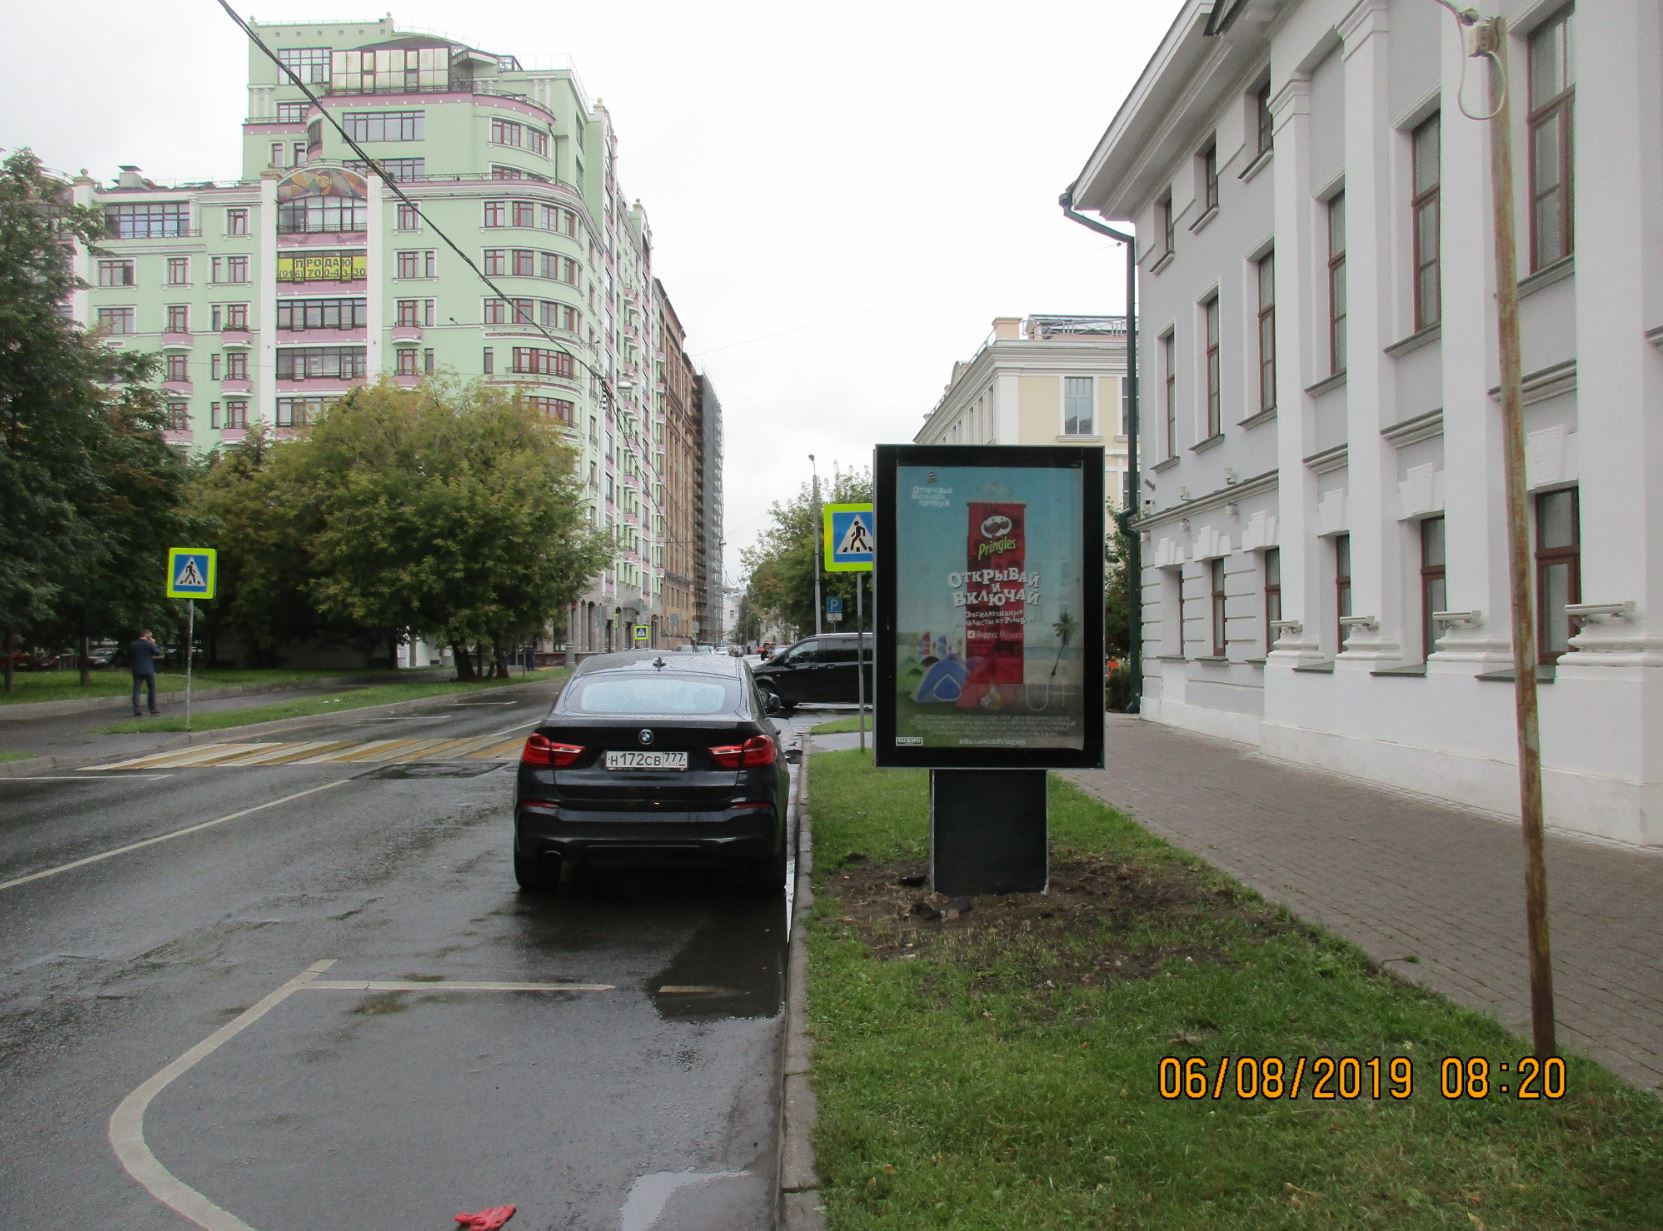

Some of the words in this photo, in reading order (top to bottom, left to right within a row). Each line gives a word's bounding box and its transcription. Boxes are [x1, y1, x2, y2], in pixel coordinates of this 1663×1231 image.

[295, 258, 351, 269] ПРОДАЮ
[978, 536, 1016, 560] Pringles
[831, 599, 839, 610] P
[610, 752, 662, 766] Н172СВ
[664, 752, 684, 763] 777
